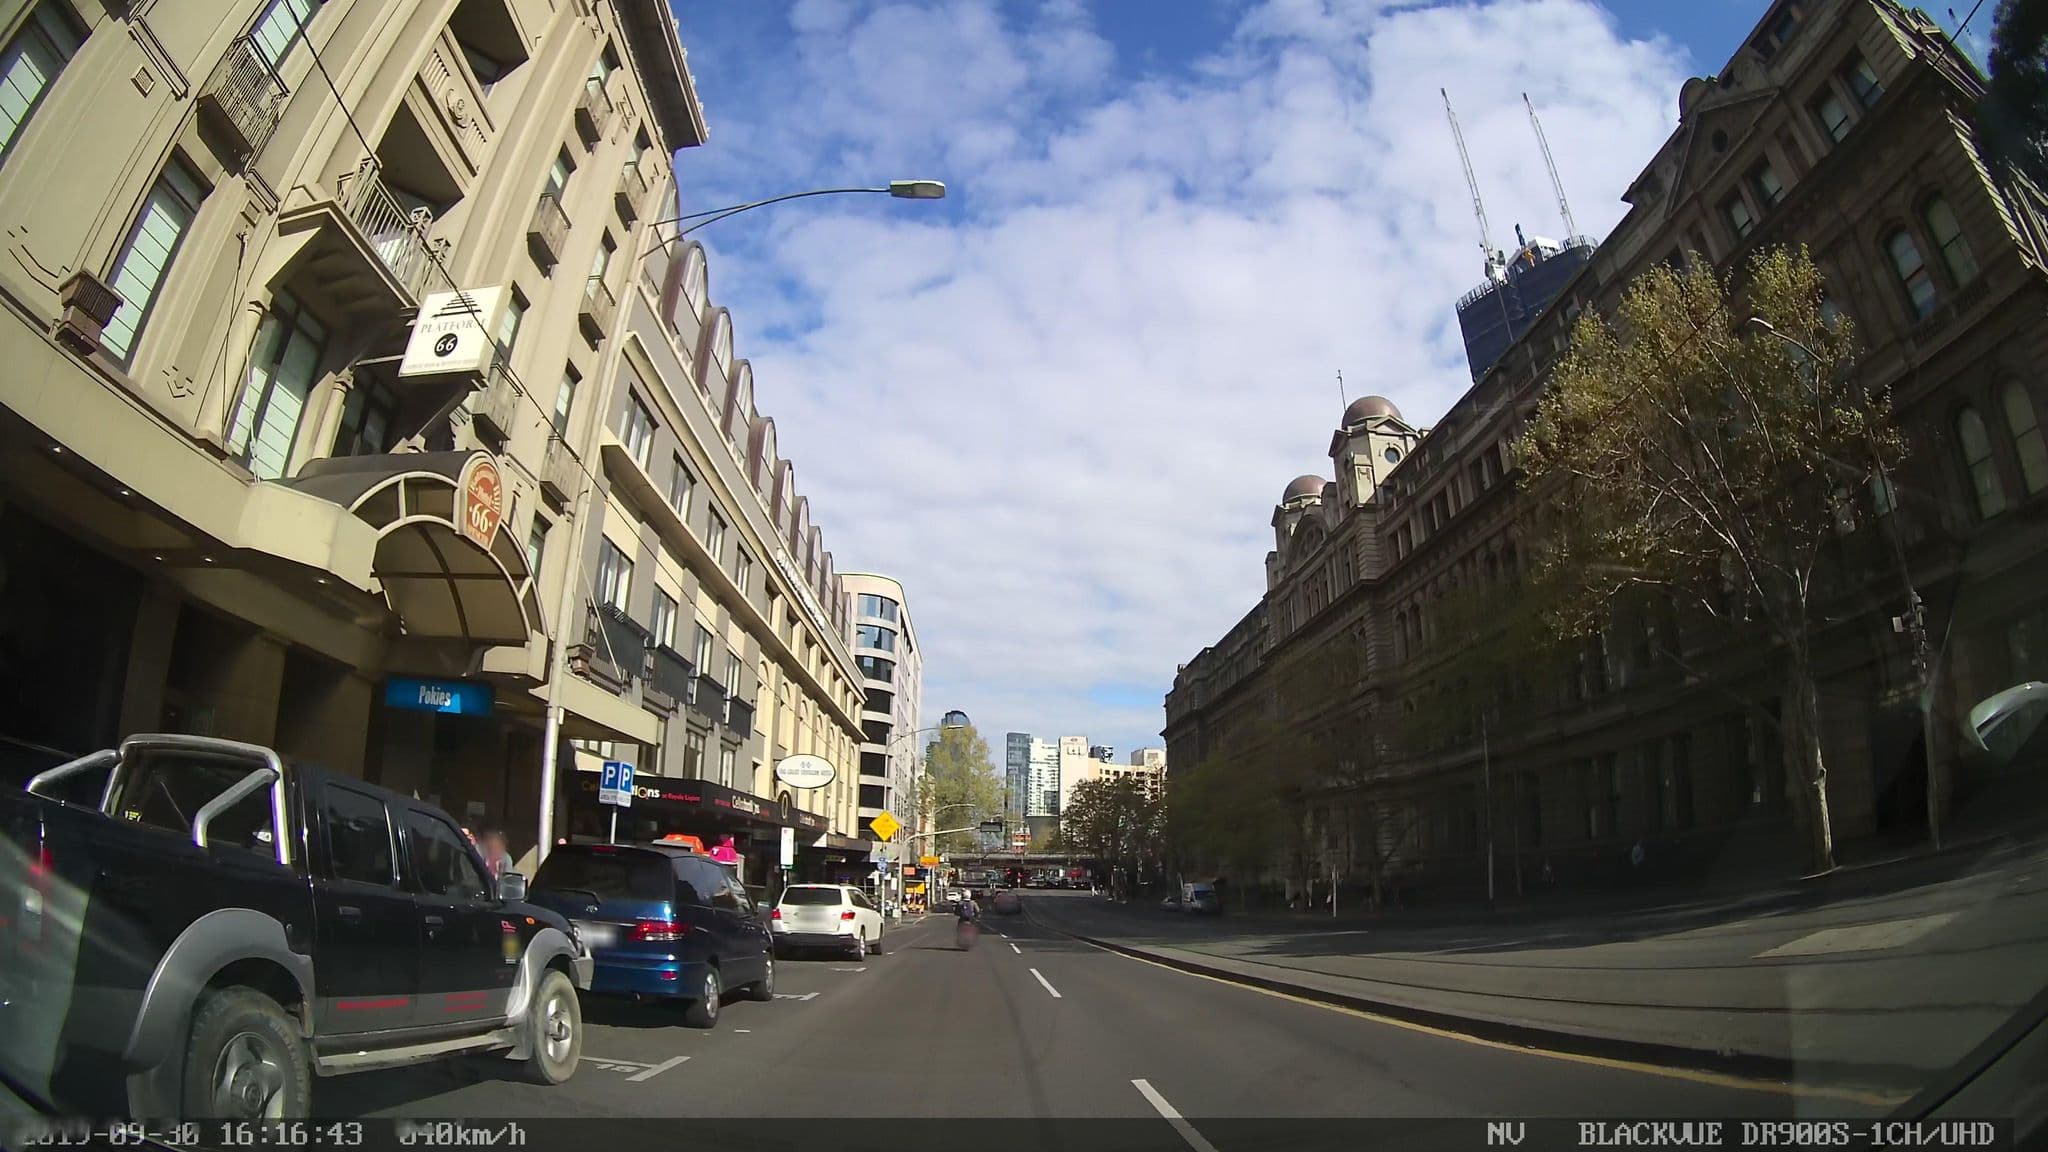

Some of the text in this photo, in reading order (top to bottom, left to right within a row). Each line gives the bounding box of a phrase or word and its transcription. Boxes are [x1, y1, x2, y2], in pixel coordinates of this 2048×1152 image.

[436, 337, 458, 352] 66
[471, 503, 491, 533] 66
[418, 685, 451, 707] Pokies
[605, 766, 616, 785] P
[621, 767, 631, 788] P
